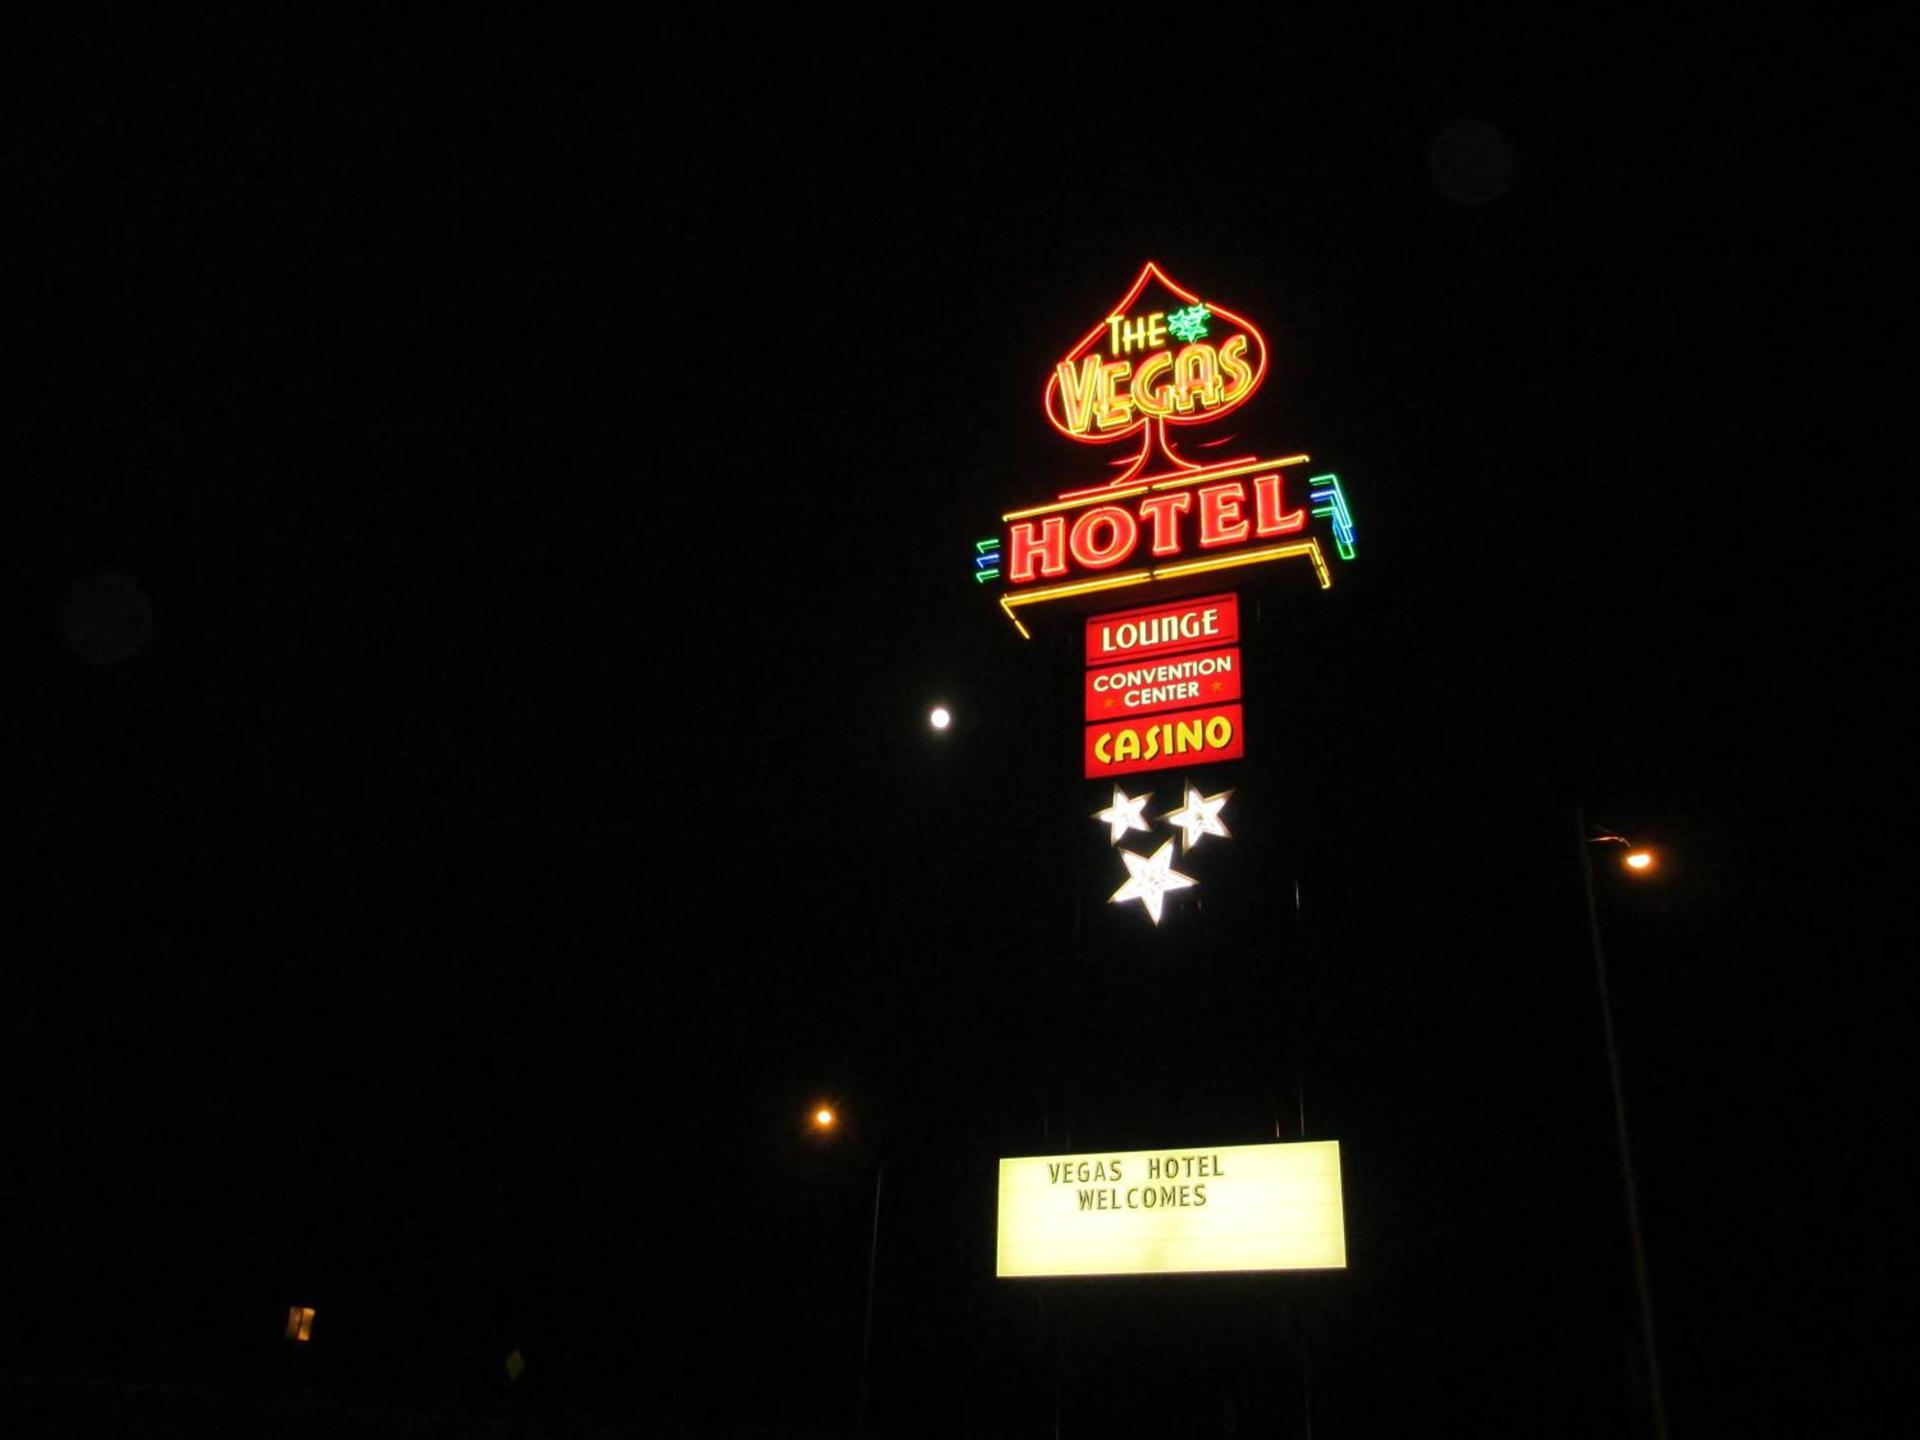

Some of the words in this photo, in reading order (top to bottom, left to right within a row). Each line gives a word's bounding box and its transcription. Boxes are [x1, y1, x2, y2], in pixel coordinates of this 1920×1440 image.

[1106, 313, 1168, 354] THE
[1057, 335, 1252, 434] VEGAS
[1009, 475, 1304, 584] HOTEL
[1102, 609, 1219, 652] LOUNGE
[1093, 656, 1232, 692] CONVENTION
[1124, 681, 1199, 707] CENTER
[1094, 715, 1232, 764] CASINO
[1049, 1160, 1123, 1184] VEGAS
[1148, 1154, 1225, 1180] HOTEL
[1078, 1184, 1208, 1211] WELCOMES
